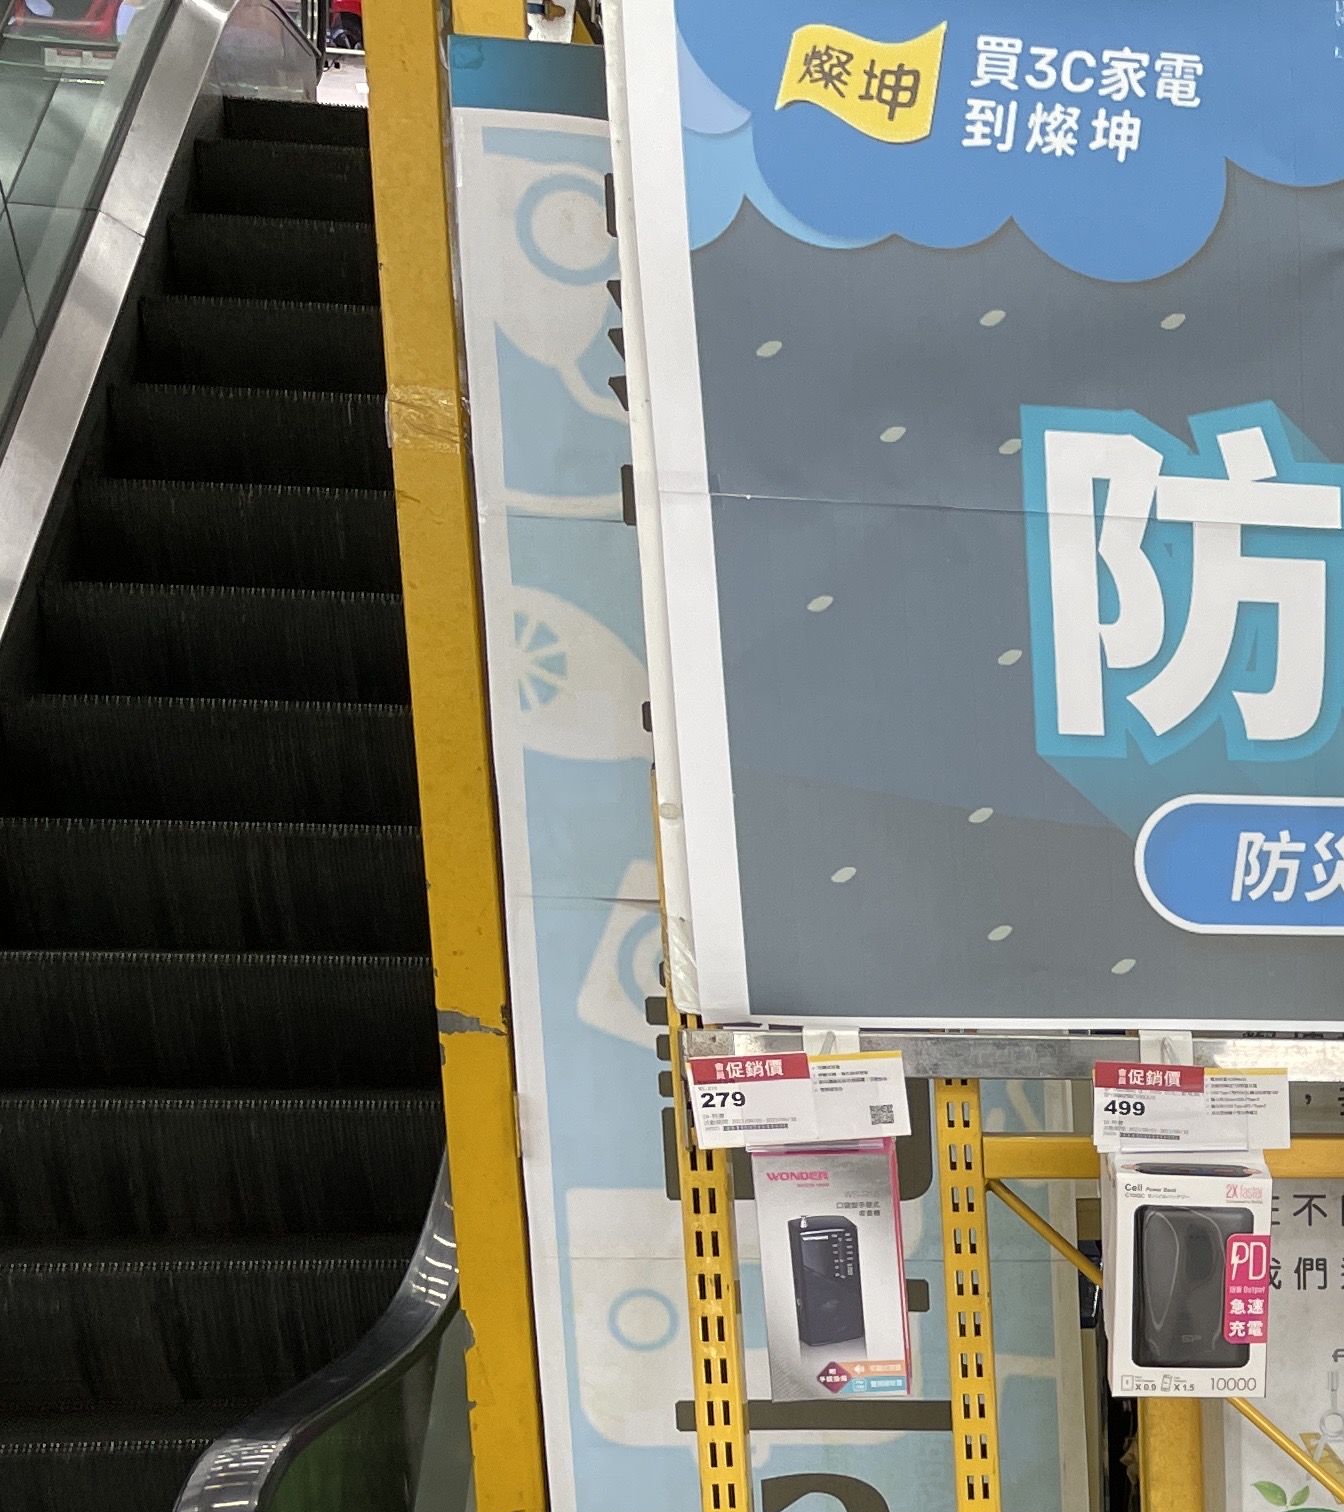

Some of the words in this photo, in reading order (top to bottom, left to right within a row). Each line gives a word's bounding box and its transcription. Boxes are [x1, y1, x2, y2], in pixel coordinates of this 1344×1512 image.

[970, 36, 1205, 107] 買3C家電
[799, 44, 922, 120] 燦坤
[962, 100, 1141, 162] 到燦坤
[726, 1059, 783, 1079] 促銷價
[1128, 1068, 1181, 1087] 促銷價
[700, 1091, 747, 1109] 279
[1103, 1100, 1146, 1117] 499
[766, 1171, 829, 1182] WONDER
[1124, 1183, 1143, 1192] Cell
[1226, 1185, 1238, 1199] 2X
[1231, 1242, 1267, 1281] PD
[1230, 1299, 1264, 1314] 急速
[1228, 1321, 1263, 1337] 充電
[1210, 1377, 1257, 1391] 10000
